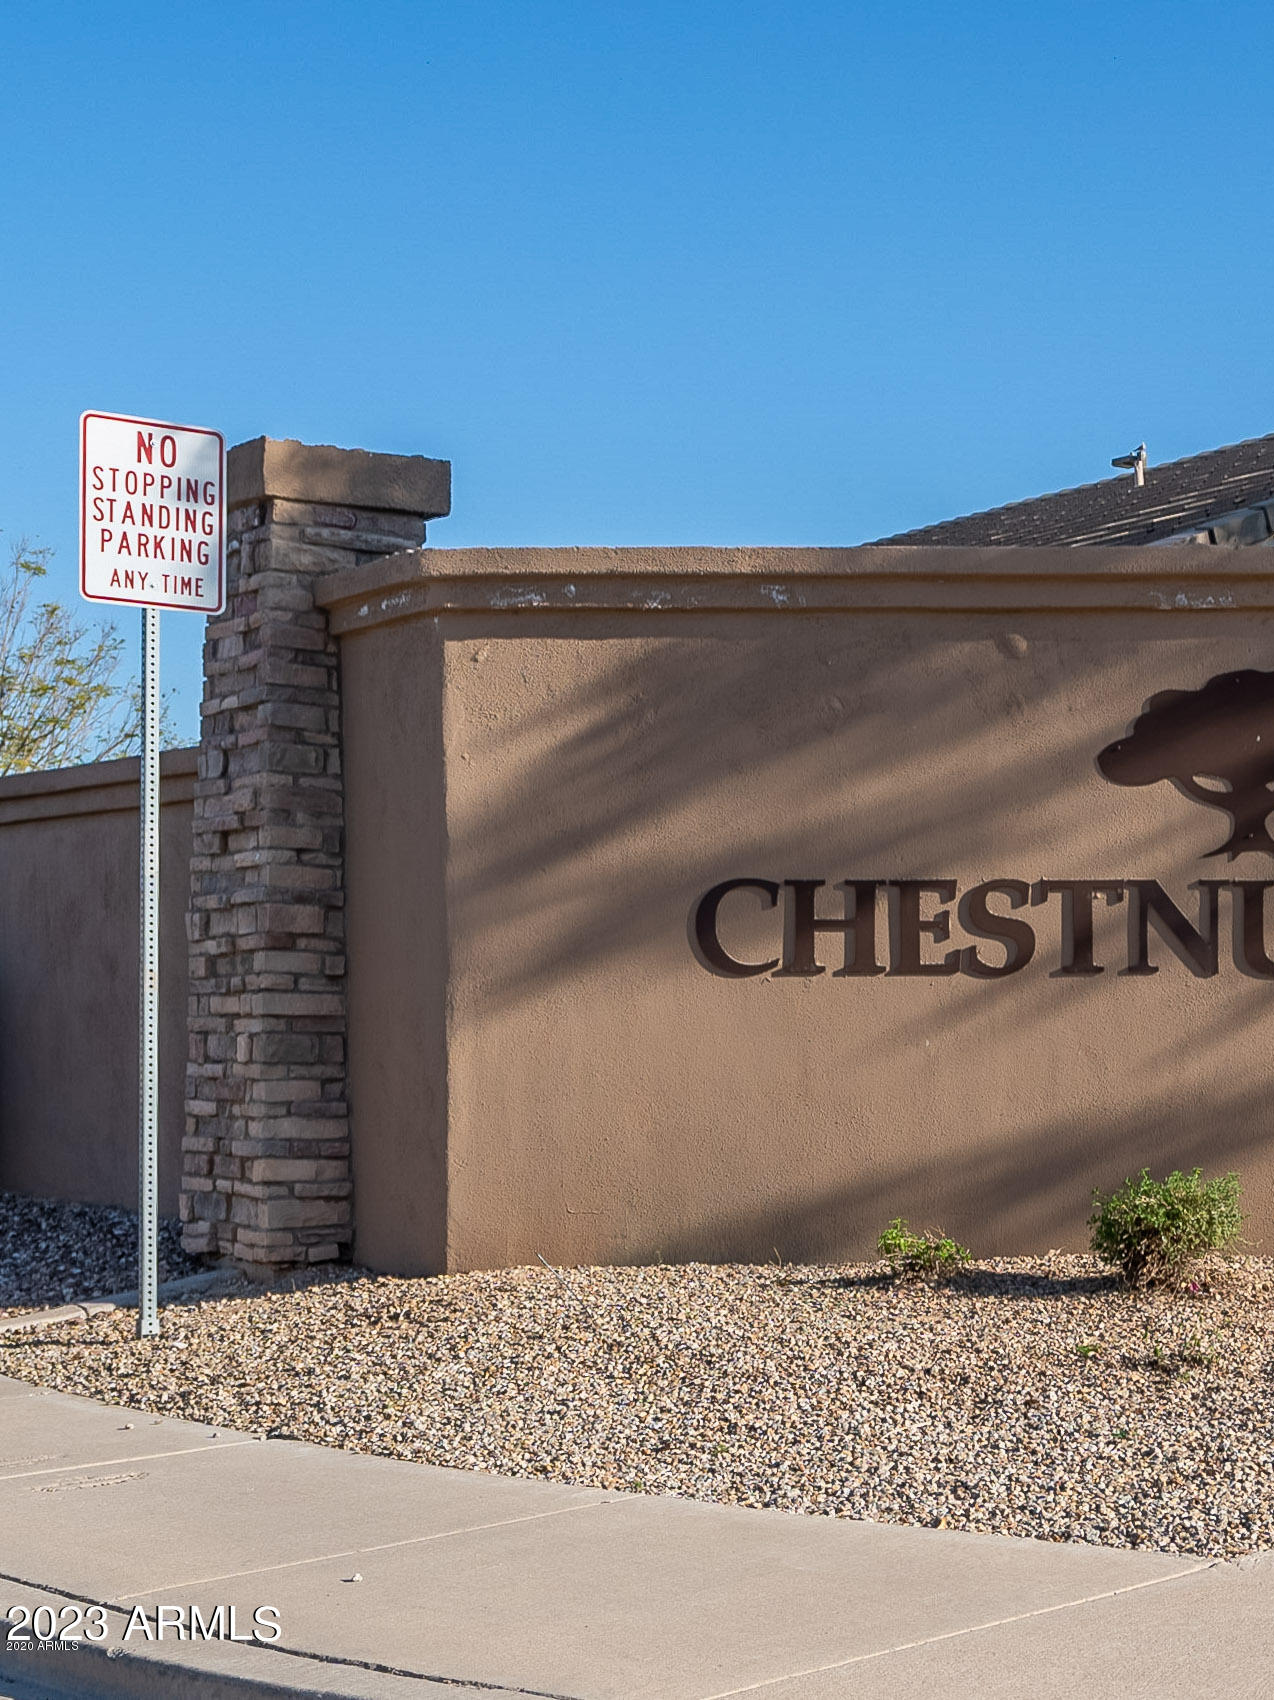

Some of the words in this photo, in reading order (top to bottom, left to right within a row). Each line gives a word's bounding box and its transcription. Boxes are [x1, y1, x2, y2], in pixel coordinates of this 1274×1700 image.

[136, 431, 177, 468] NO
[92, 466, 216, 506] STOPPING
[92, 497, 214, 536] STANDING
[100, 528, 210, 566] PARKING
[110, 568, 149, 590] ANY
[162, 574, 204, 597] TIME
